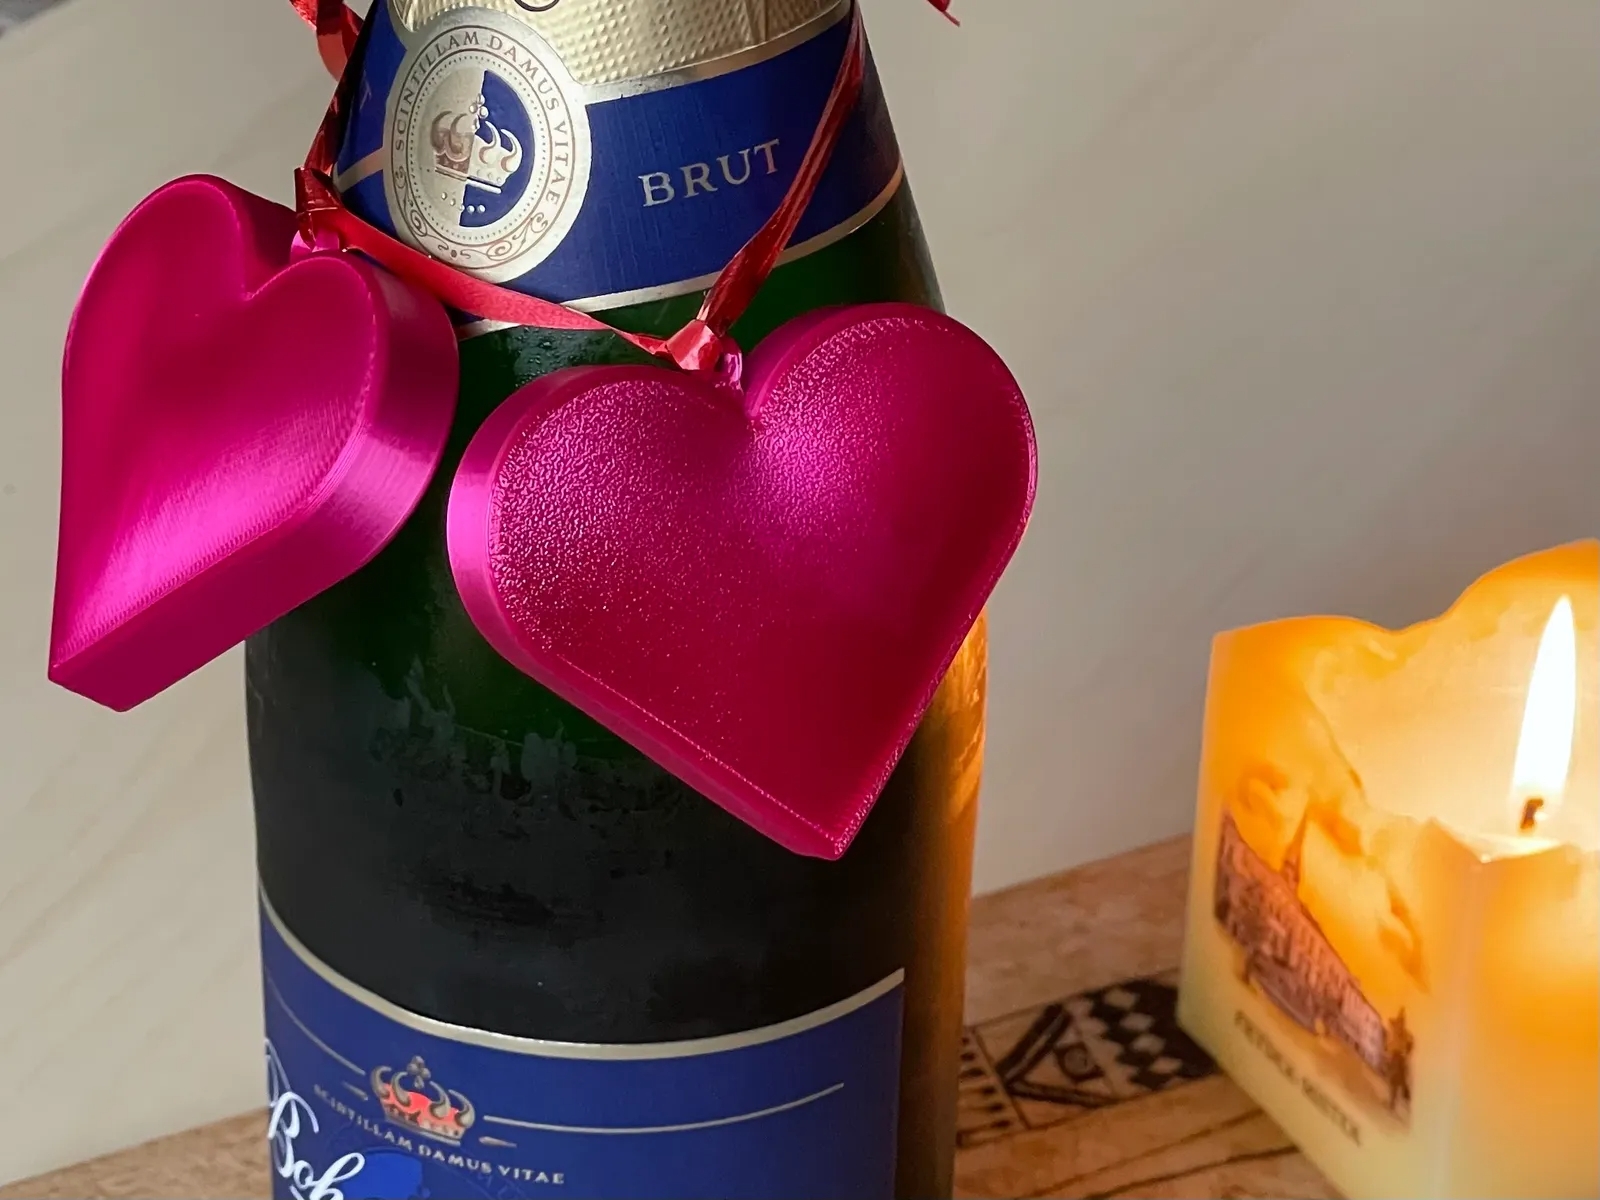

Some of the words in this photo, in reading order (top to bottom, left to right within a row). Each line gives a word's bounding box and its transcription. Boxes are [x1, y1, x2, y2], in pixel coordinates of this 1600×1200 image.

[396, 31, 479, 151] SCINTILLAM
[486, 35, 560, 111] DAMUS
[545, 120, 569, 205] VITAE
[638, 138, 780, 207] BRUT
[418, 1144, 492, 1174] DAMUS
[498, 1164, 565, 1185] VITAE
